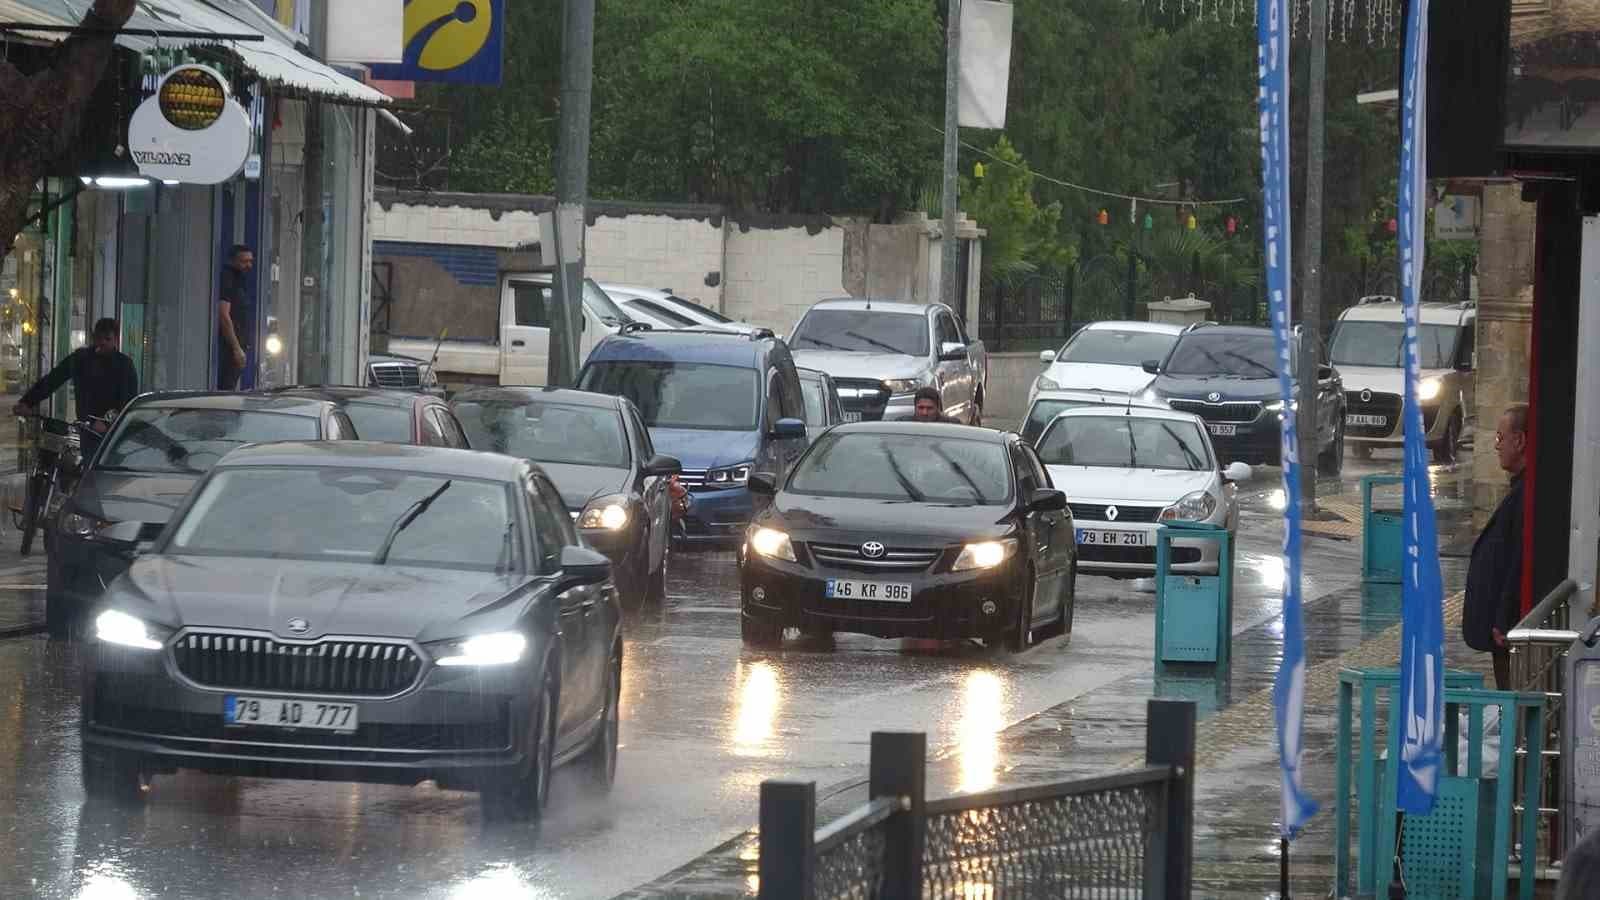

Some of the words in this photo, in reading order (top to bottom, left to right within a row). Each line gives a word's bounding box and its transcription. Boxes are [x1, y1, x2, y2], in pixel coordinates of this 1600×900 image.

[133, 150, 191, 166] YILMAZ
[1082, 531, 1096, 543] 79
[1103, 532, 1117, 544] EH
[1123, 533, 1143, 545] 201
[836, 582, 852, 596] 46
[861, 583, 877, 598] KR
[885, 584, 908, 599] 986
[236, 699, 260, 721] 79
[279, 702, 303, 724] AD
[315, 704, 353, 726] 777
